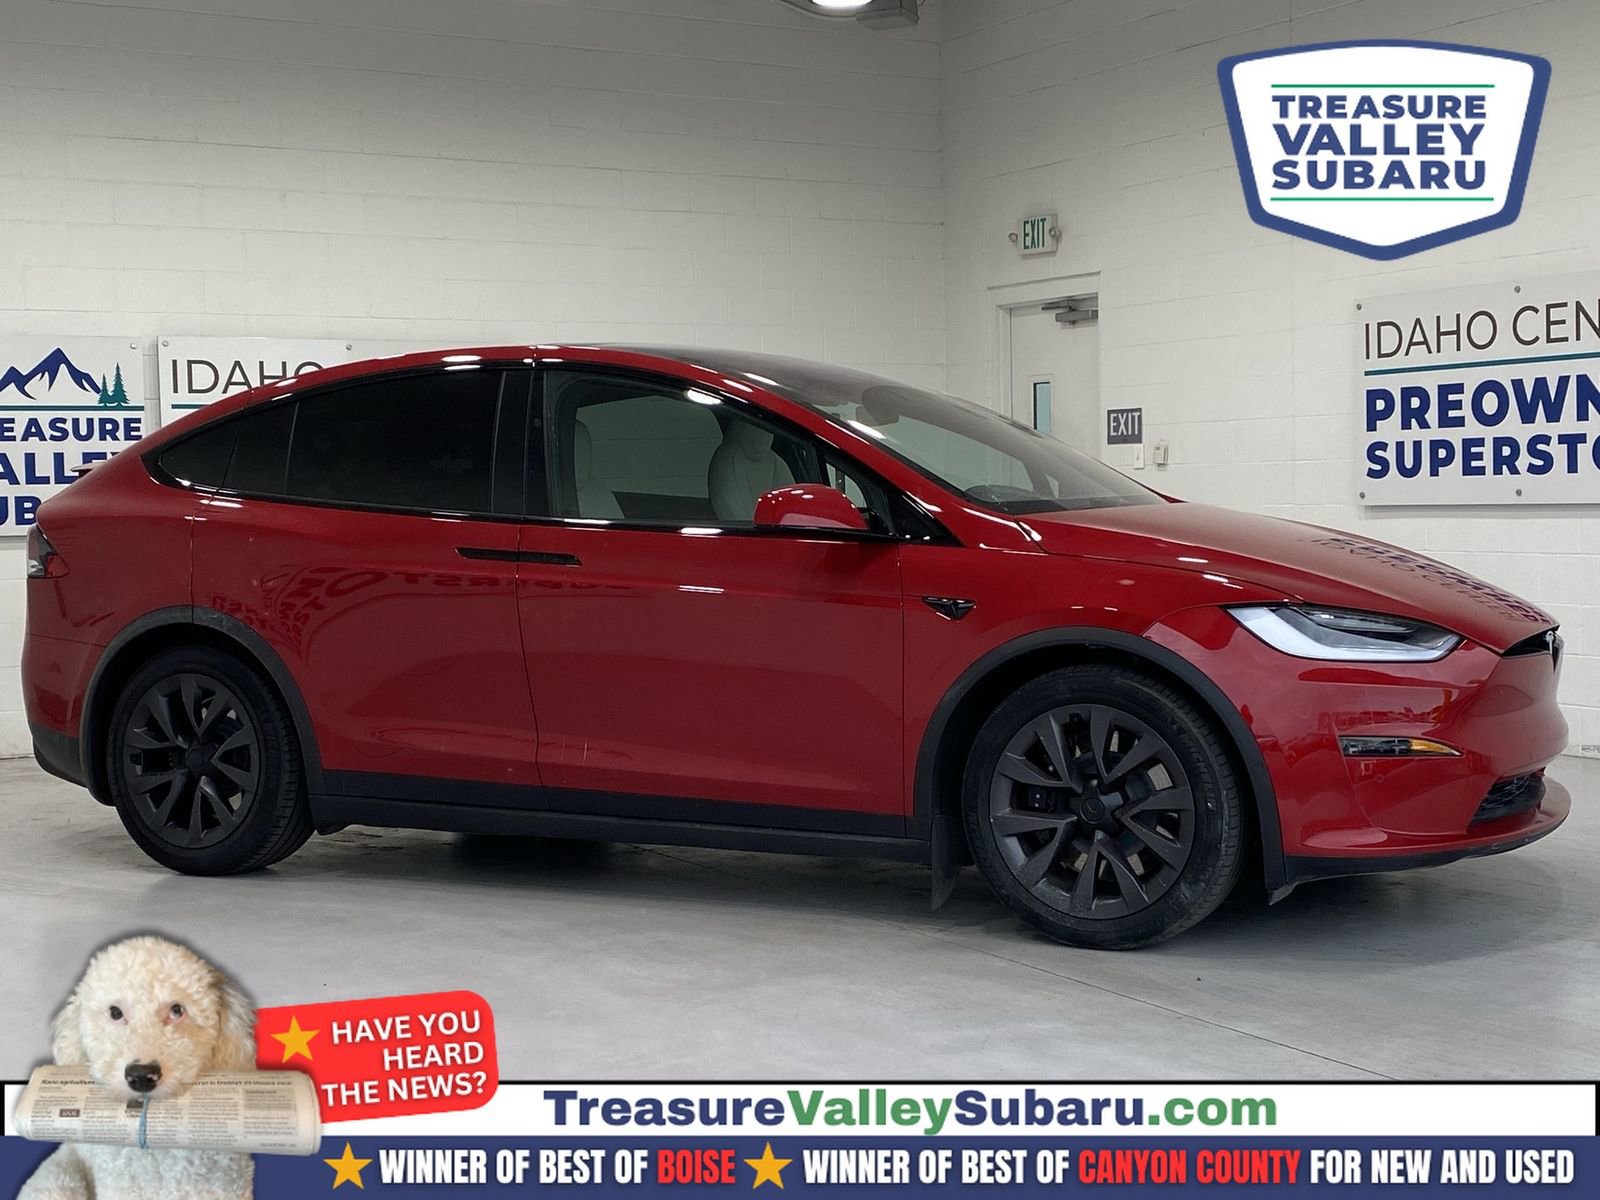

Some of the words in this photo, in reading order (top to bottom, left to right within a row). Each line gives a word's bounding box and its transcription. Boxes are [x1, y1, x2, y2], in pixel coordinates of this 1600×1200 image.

[1023, 216, 1047, 250] EXIT
[1365, 310, 1498, 360] IDAHO
[1110, 411, 1141, 436] EXIT
[1366, 373, 1600, 432] PREOWN
[1366, 432, 1600, 480] SUPERST
